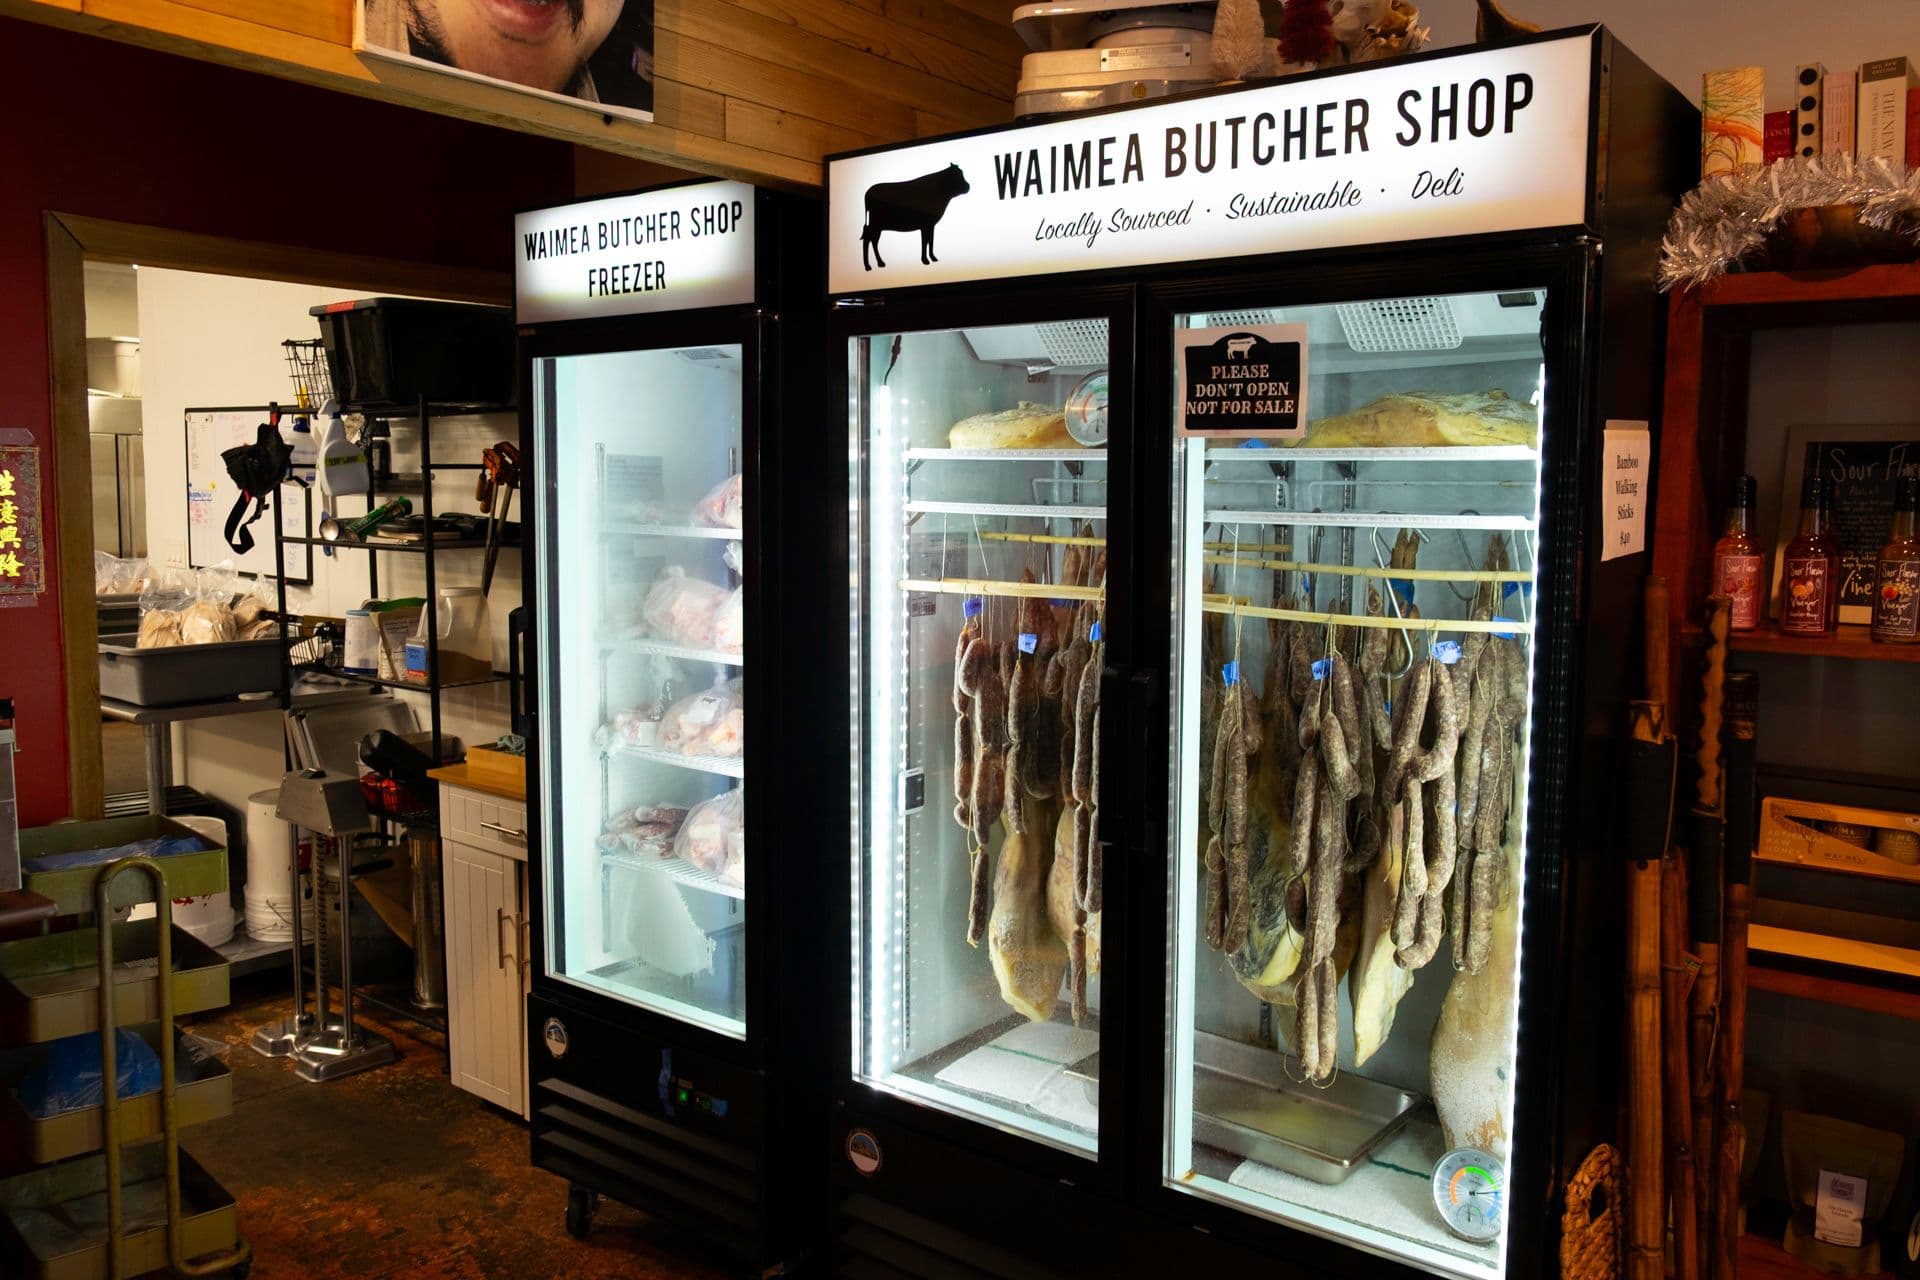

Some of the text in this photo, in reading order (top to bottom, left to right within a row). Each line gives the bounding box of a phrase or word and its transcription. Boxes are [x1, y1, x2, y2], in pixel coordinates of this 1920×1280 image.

[994, 72, 1534, 201] WAIMEA BUTCHER SHOP
[1035, 167, 1464, 248] Locally Sourced Sustainable Deli
[525, 201, 742, 261] WAIMEA BUTCHER SHOP
[589, 260, 666, 297] FREEZER
[1211, 364, 1270, 379] PLEASE
[1195, 381, 1289, 398] DON'T OPEN
[1186, 400, 1294, 415] NOT FOR SALE
[1616, 454, 1639, 470] Bamboo
[1830, 448, 1879, 482] Sour
[1615, 479, 1638, 496] Walking
[1617, 504, 1634, 520] Sticks
